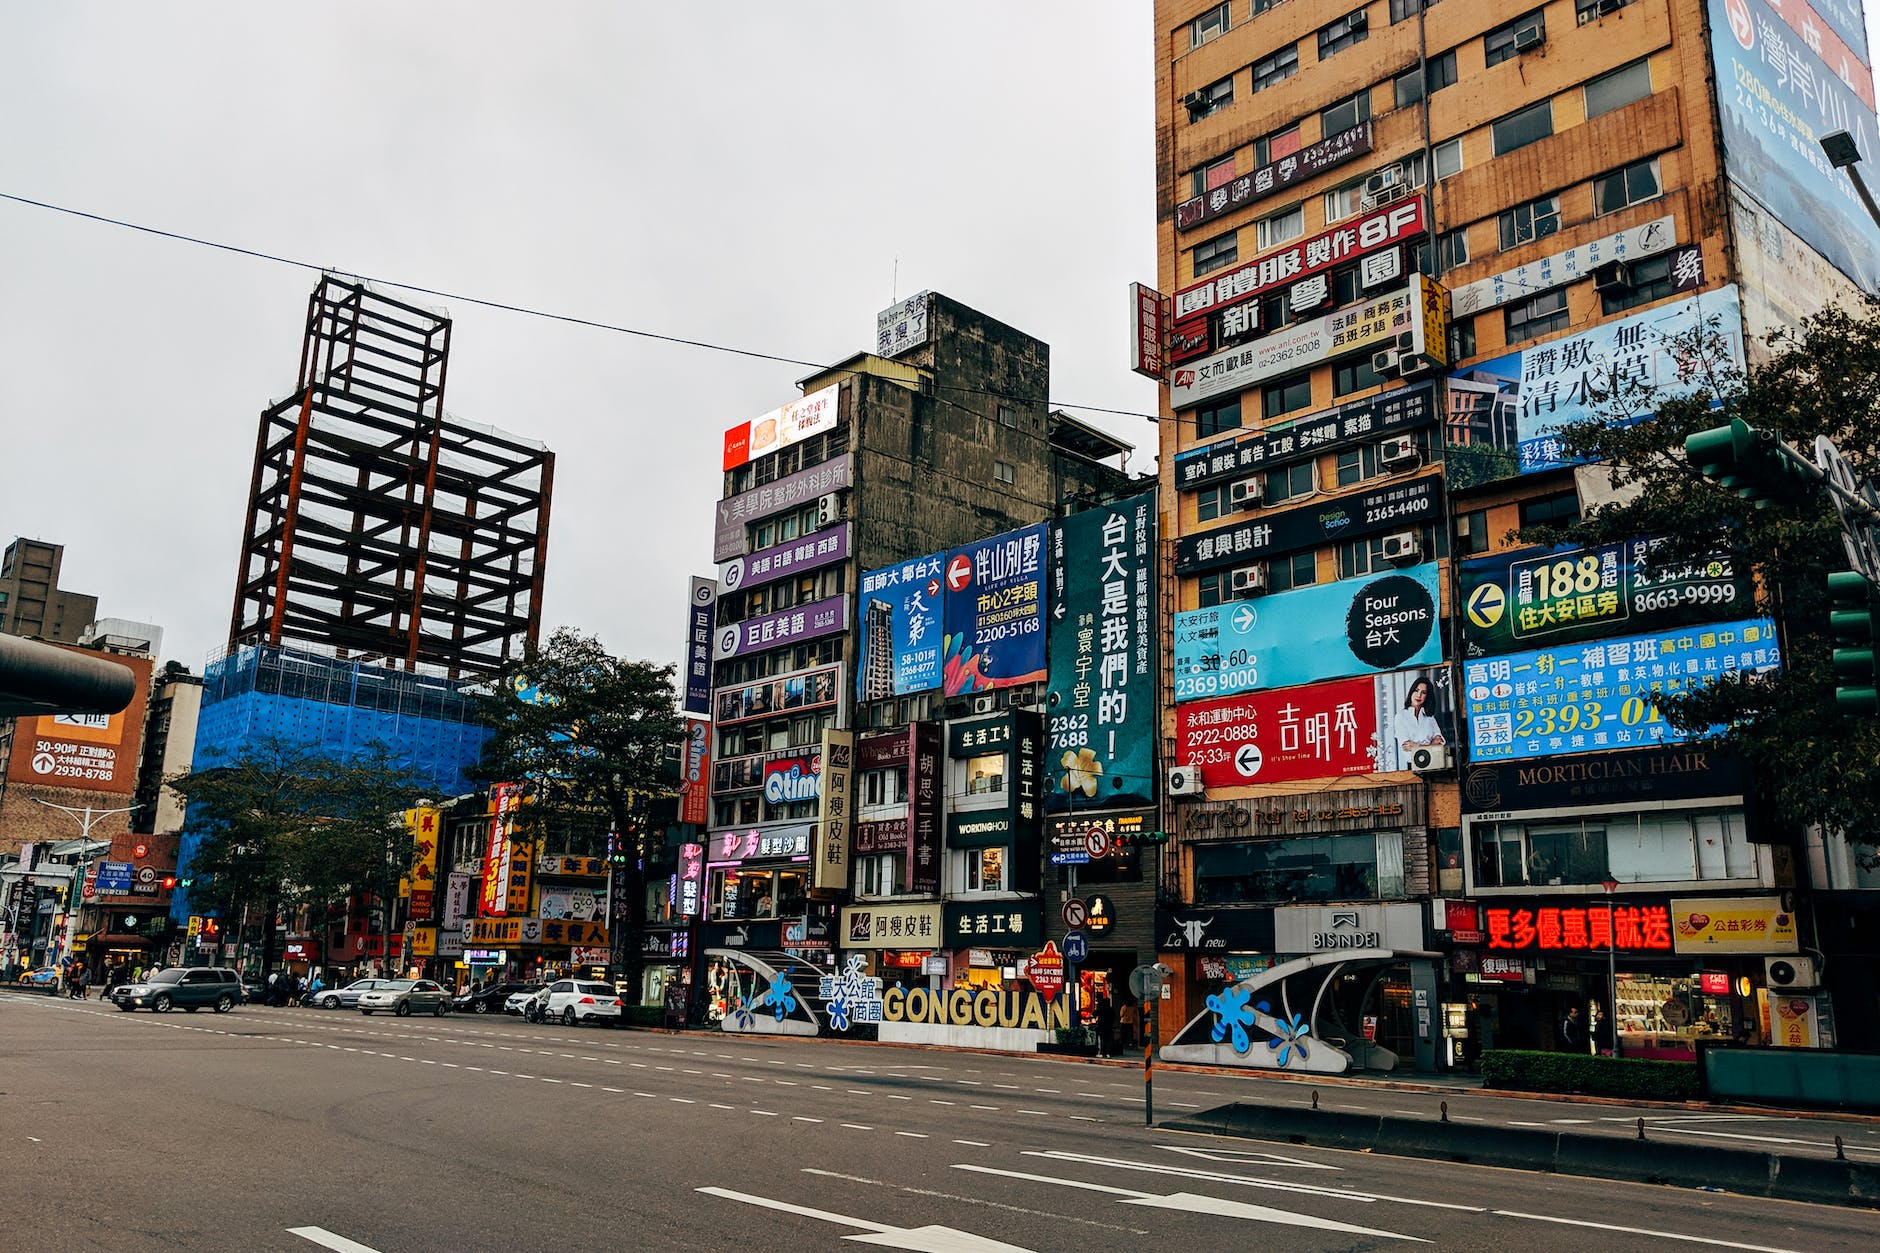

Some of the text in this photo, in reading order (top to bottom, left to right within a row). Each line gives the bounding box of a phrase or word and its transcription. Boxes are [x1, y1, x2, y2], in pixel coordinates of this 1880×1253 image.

[1364, 293, 1412, 321] 商務英
[1332, 312, 1358, 332] 法語
[1332, 318, 1386, 348] 西班牙語
[1295, 339, 1321, 357] 5008
[1185, 460, 1207, 481] 室內
[1211, 453, 1236, 474] 服裝
[1241, 445, 1265, 465] 廣告
[1344, 413, 1372, 437] 素描
[1366, 497, 1429, 524] 2365-4400
[1197, 523, 1273, 562] 復興設計
[751, 557, 771, 576] 美語
[773, 550, 792, 569] 日語
[817, 535, 838, 556] 西語
[974, 533, 1040, 586] 伴山別墅
[1532, 556, 1600, 600] 188
[977, 581, 1039, 613] 市心2字頭
[1365, 594, 1399, 612] Four
[1634, 583, 1736, 613] 8663-9999
[1177, 611, 1219, 629] 大安行旅
[1519, 590, 1619, 632] 住大安區旁
[747, 612, 804, 646] 巨匠美語
[976, 616, 1040, 645] 2200-5168
[1365, 628, 1401, 649] 台大
[1229, 648, 1247, 667] 60
[1050, 713, 1089, 733] 2362
[1187, 704, 1258, 729] 永和運動中心
[35, 740, 78, 755] 50-90坪
[1050, 730, 1089, 750] 7688
[1187, 723, 1258, 748] 2922-0888
[54, 765, 113, 782] 2930-8788
[1020, 737, 1034, 820] 生活工場
[1518, 751, 1711, 787] MORTICIAN HAIR
[827, 772, 845, 866] 阿瘦皮鞋
[918, 752, 934, 866] 胡思二手書
[141, 872, 153, 880] 40
[876, 914, 933, 938] 阿瘦皮鞋
[958, 913, 1024, 935] 生活工場
[1486, 906, 1672, 950] 更多優惠買就送
[1713, 918, 1767, 932] 公益彩券
[724, 935, 744, 946] PUMA
[1163, 932, 1227, 949] La new
[819, 976, 875, 999] 臺大公館
[853, 1001, 882, 1022] 商圈
[883, 987, 1070, 1030] GONGGUAN
